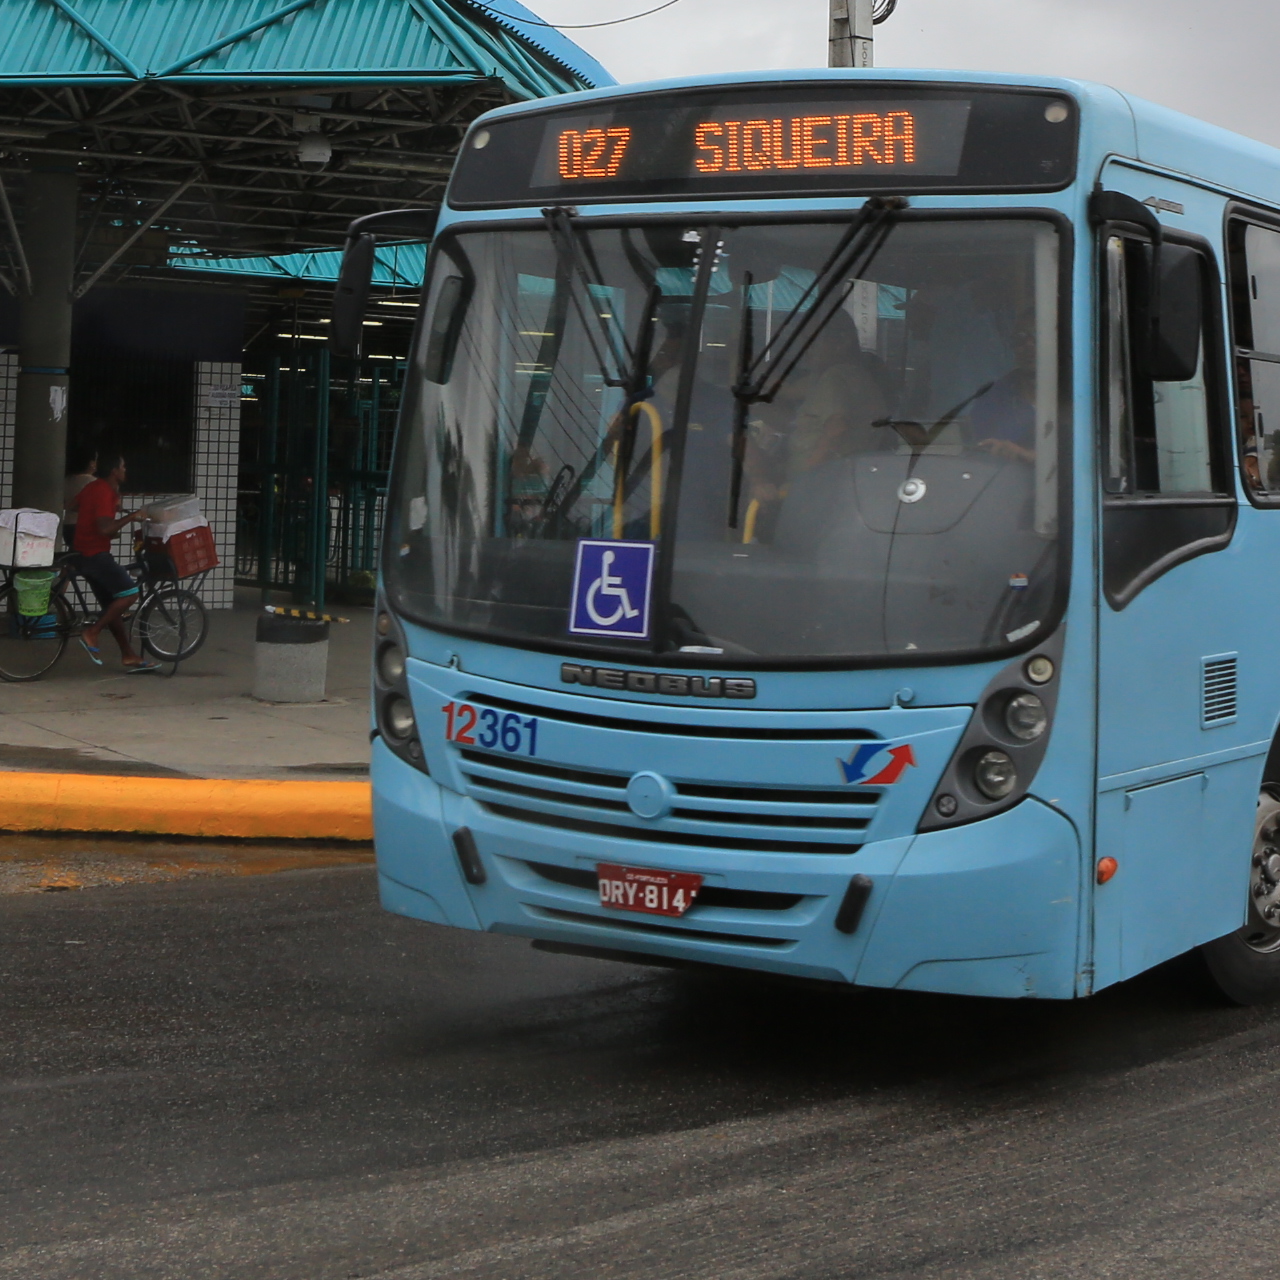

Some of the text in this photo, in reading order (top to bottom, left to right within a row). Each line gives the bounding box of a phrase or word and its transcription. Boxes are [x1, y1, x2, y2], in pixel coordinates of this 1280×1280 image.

[558, 111, 914, 180] 027 SIQUEIRA
[561, 662, 757, 700] NEOBUS
[441, 701, 539, 757] 12361
